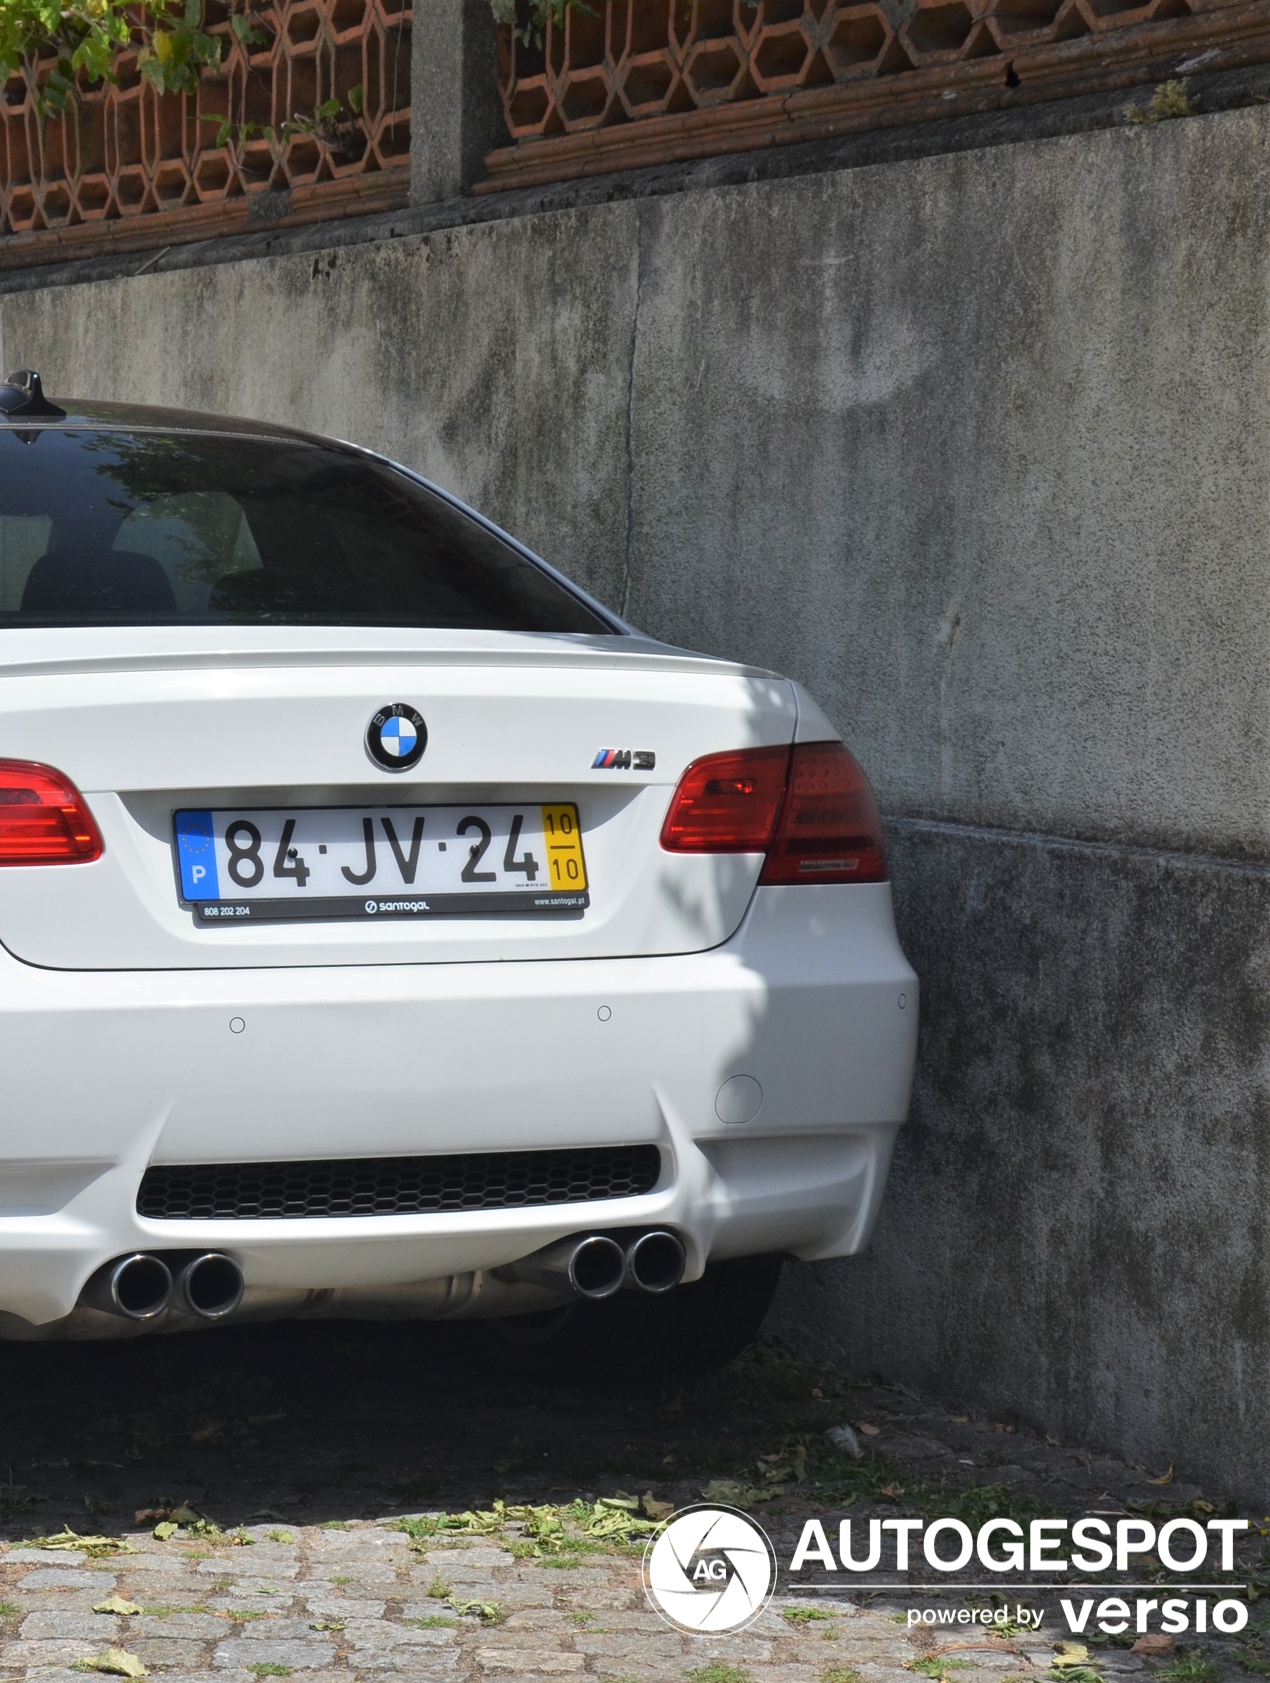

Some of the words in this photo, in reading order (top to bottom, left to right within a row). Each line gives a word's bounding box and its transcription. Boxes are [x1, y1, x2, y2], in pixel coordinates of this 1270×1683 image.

[373, 705, 423, 727] BMW
[596, 748, 656, 771] M3
[546, 813, 573, 835] 10
[192, 865, 206, 884] P
[552, 858, 579, 881] 10
[204, 907, 219, 916] 808
[220, 907, 234, 916] 202
[235, 906, 250, 915] 204
[534, 897, 585, 906] www.santogal.pt
